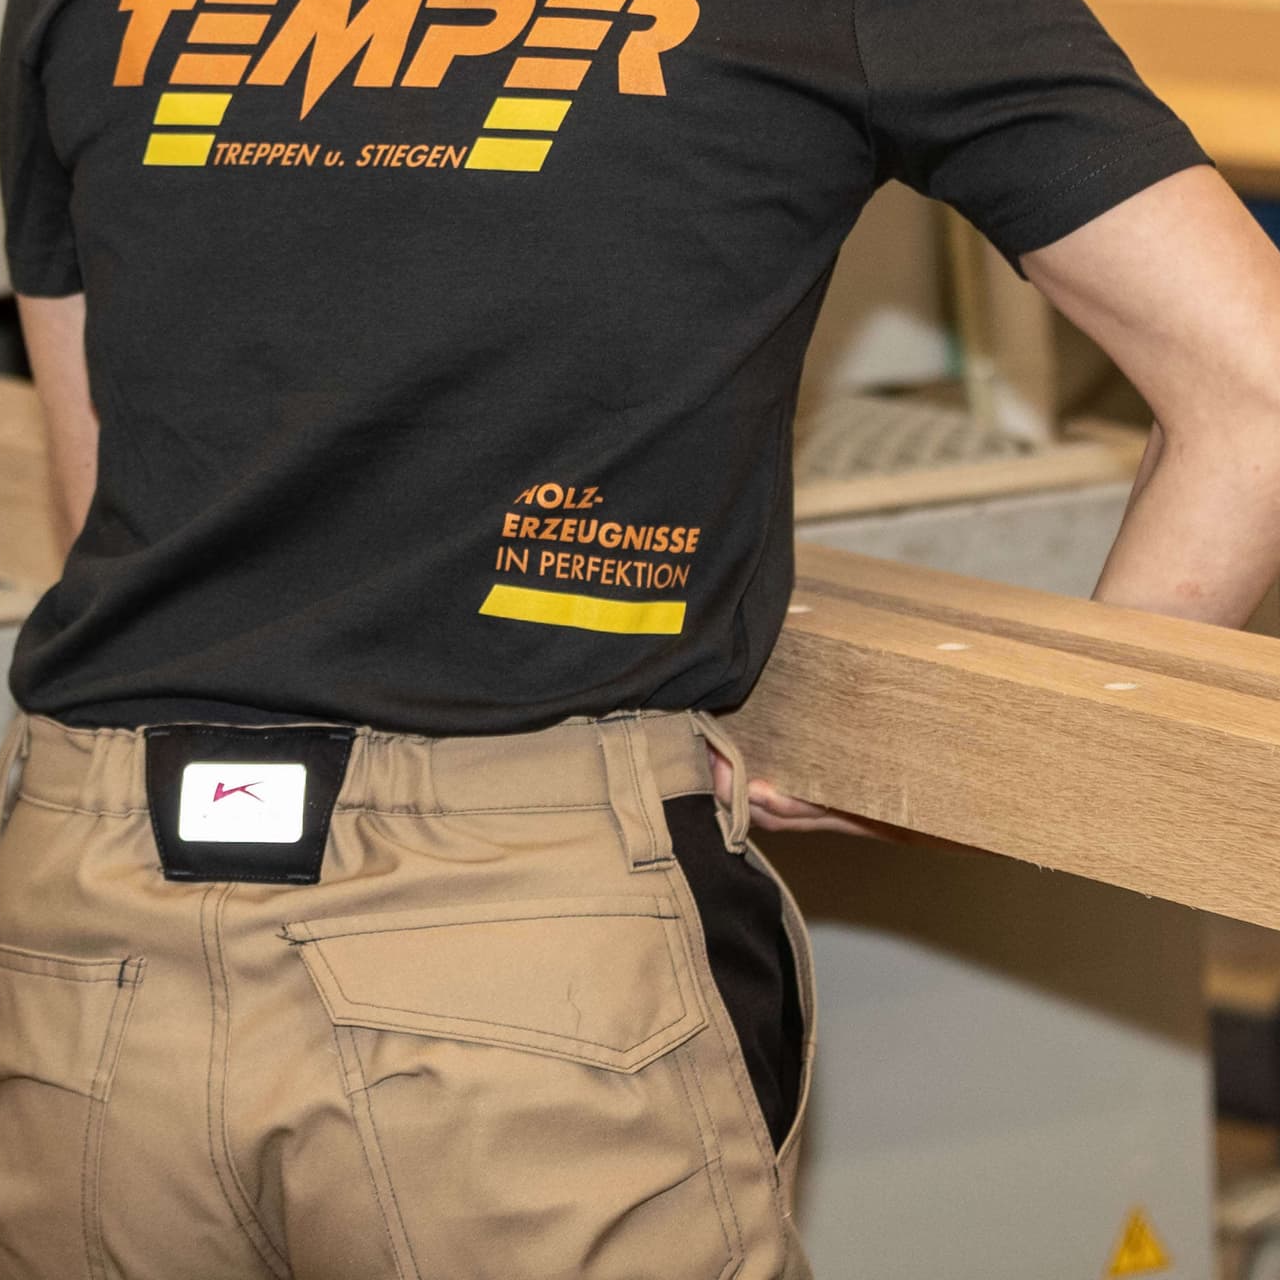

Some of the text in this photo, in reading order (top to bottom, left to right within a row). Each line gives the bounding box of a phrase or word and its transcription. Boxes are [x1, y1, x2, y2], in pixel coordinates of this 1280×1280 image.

[212, 143, 467, 169] TREPPEN u. STIEGEN
[501, 512, 701, 553] ERZEUGNISSE
[495, 546, 690, 589] IN PERFEKTION
